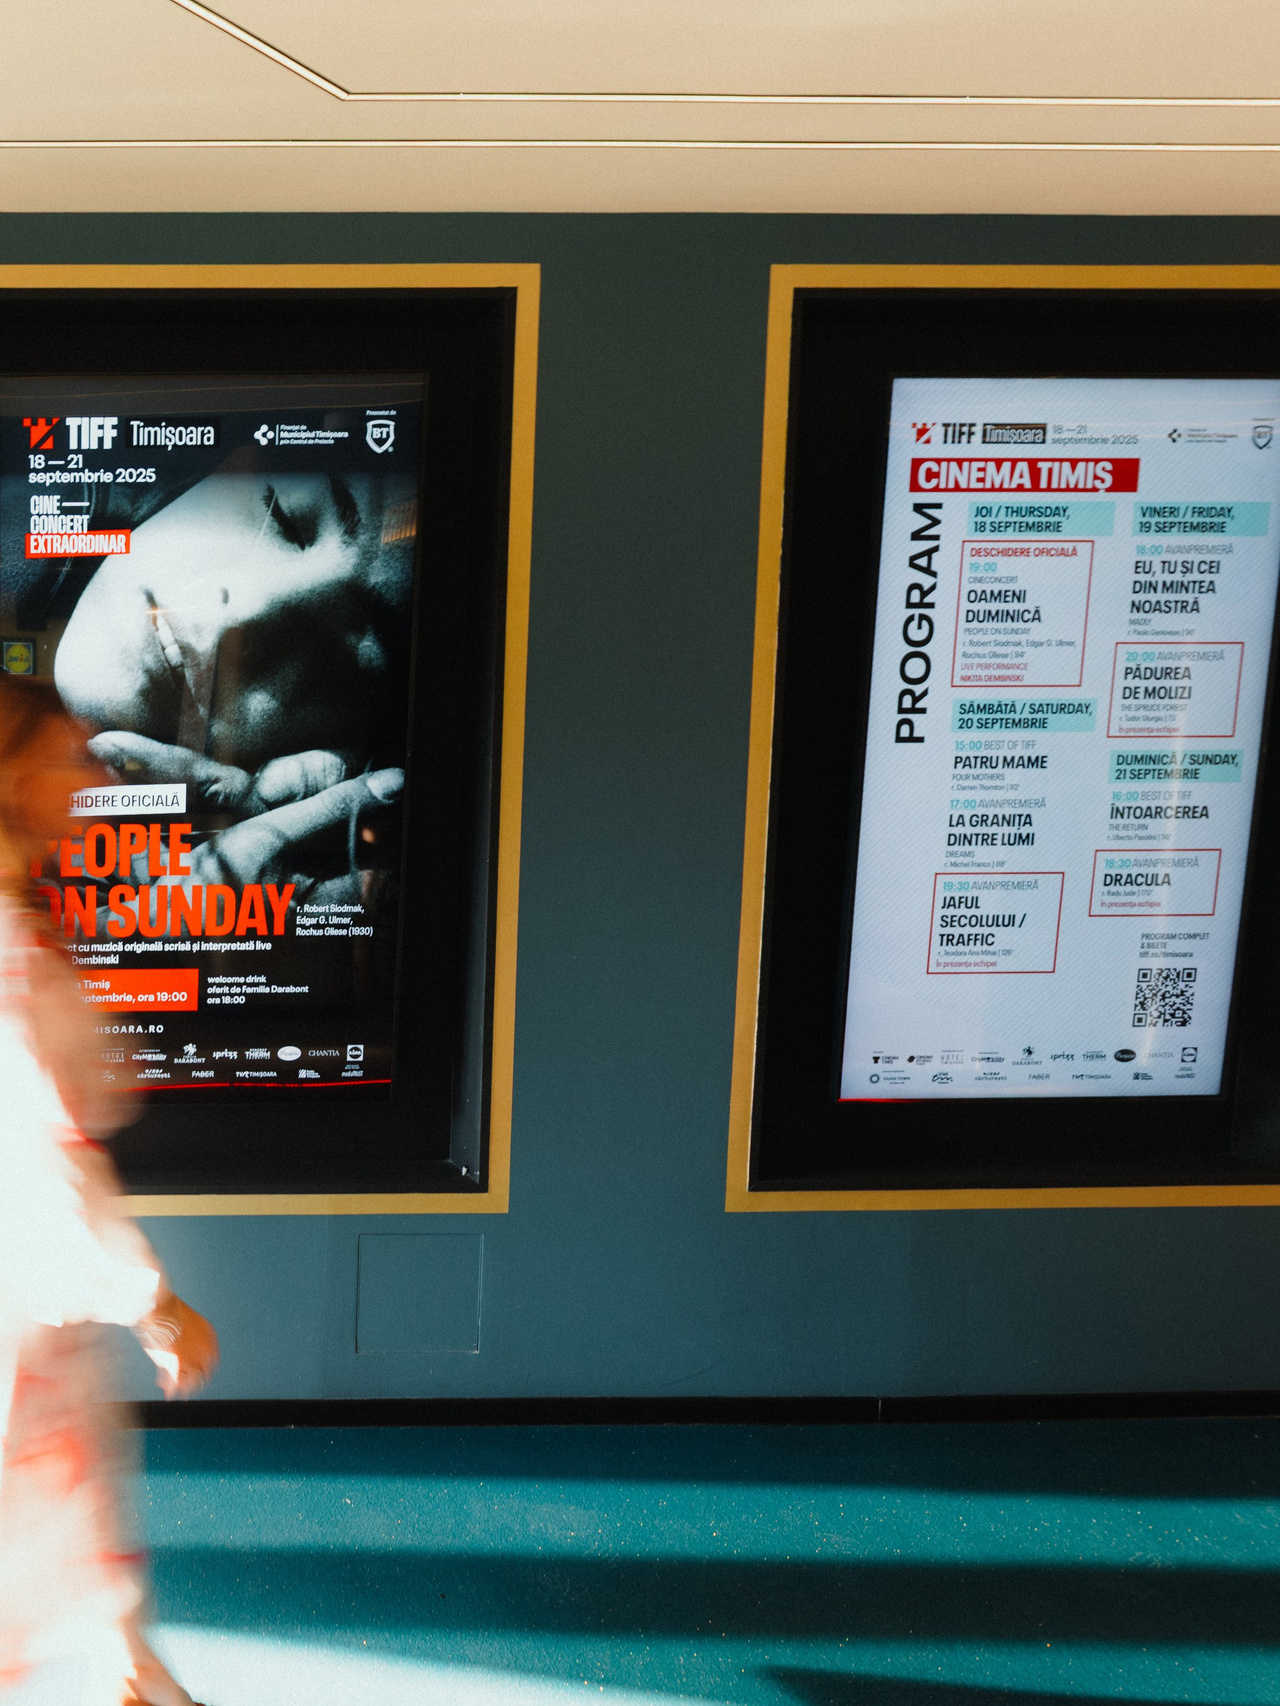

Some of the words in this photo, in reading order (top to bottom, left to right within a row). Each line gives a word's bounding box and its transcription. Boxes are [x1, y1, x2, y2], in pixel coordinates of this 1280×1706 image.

[65, 417, 118, 450] TIFF
[130, 421, 215, 451] Timișoara
[372, 428, 390, 439] BT
[942, 423, 977, 444] TIFF
[1111, 435, 1139, 444] 2025
[28, 454, 45, 469] 18
[67, 454, 83, 469] 21
[28, 469, 113, 487] septembrie
[115, 468, 156, 483] 2025
[917, 460, 1032, 490] CINEMA
[1037, 461, 1113, 493] TIMIȘ
[30, 494, 61, 515] CINE
[975, 506, 993, 518] JOI
[1005, 506, 1070, 520] THURSDAY,
[1141, 506, 1180, 518] VINERI
[1191, 506, 1235, 520] FRIDAY,
[30, 515, 90, 534] CONCERT
[974, 521, 986, 532] 18
[989, 521, 1063, 532] SEPTEMBRIE
[1139, 521, 1152, 533] 19
[1154, 521, 1226, 533] SEPTEMBRIE
[30, 534, 126, 553] EXTRAORDINAR
[970, 547, 1031, 557] DESCHIDERE
[1033, 546, 1078, 557] OFICIALĂ
[969, 562, 997, 573] 19:00
[1134, 560, 1156, 577] EU,
[1161, 560, 1177, 574] TU
[1180, 560, 1194, 577] ȘI
[1197, 560, 1221, 574] CEI
[968, 576, 1018, 584] CINECONCERT
[1132, 580, 1158, 594] DIN
[1161, 580, 1216, 594] MINTEA
[967, 589, 1027, 603] OAMENI
[1130, 597, 1200, 613] NOASTRĂ
[965, 606, 1041, 623] DUMINICĂ
[894, 502, 943, 744] PROGRAM
[1124, 664, 1192, 680] PĂDUREA
[1122, 686, 1140, 700] DE
[1143, 686, 1192, 700] MOLIZI
[959, 701, 1017, 714] SÂMBĂTĂ
[1028, 703, 1093, 716] SATURDAY,
[958, 718, 973, 729] 20
[976, 718, 1048, 729] SEPTEMBRIE
[955, 741, 982, 750] 15:00
[984, 740, 1005, 750] BEST
[1007, 740, 1019, 749] OF
[1021, 740, 1036, 749] TIFF
[953, 756, 999, 769] PATRU
[1002, 756, 1048, 769] MAME
[1116, 752, 1177, 766] DUMINICĂ
[1189, 754, 1239, 767] SUNDAY,
[952, 773, 971, 781] FOUR
[972, 773, 1005, 781] MOTHERS
[1115, 768, 1127, 780] 21
[1129, 768, 1200, 780] SEPTEMBRIE
[71, 794, 118, 808] HIDERE
[121, 792, 180, 807] OFICIALĂ
[1141, 791, 1161, 800] BEST
[950, 799, 976, 809] 17:00
[978, 797, 1047, 808] AVANPREMIERĂ
[1110, 803, 1209, 819] ÎNTOARCEREA
[948, 814, 965, 828] LA
[969, 814, 1033, 830] GRANIȚA
[947, 833, 998, 847] DINTRE
[1001, 833, 1035, 846] LUMI
[1104, 859, 1131, 868] 18:30
[943, 881, 970, 891] 19:30
[971, 879, 1039, 891] AVANPREMIERĂ
[1103, 873, 1171, 887] DRACULA
[304, 904, 329, 913] Robert
[330, 904, 365, 914] Siodmak,
[941, 896, 981, 909] JAFUL
[107, 883, 296, 938] SUNDAY
[296, 916, 318, 926] Edgar
[319, 916, 327, 924] G.
[329, 916, 353, 925] Ulmer,
[940, 914, 1016, 928] SECOLULUI
[296, 927, 323, 936] Rochus
[324, 927, 347, 936] Gliese
[348, 926, 373, 937] (1930)
[939, 933, 995, 947] TRAFFIC
[91, 942, 123, 952] muzică
[124, 941, 163, 954] originală
[164, 941, 191, 951] scrisă
[201, 941, 255, 953] interpretată
[256, 941, 272, 951] live
[72, 955, 119, 965] Dembinski
[83, 979, 111, 991] Timiș
[207, 975, 245, 983] welcome
[246, 975, 266, 983] drink
[207, 986, 229, 994] oferit
[230, 985, 241, 993] de
[242, 985, 270, 993] Familia
[271, 985, 309, 993] Darabont
[81, 992, 136, 1004] ptembrie,
[137, 994, 154, 1002] ora
[156, 992, 188, 1002] 19:00
[221, 996, 245, 1004] 18:00
